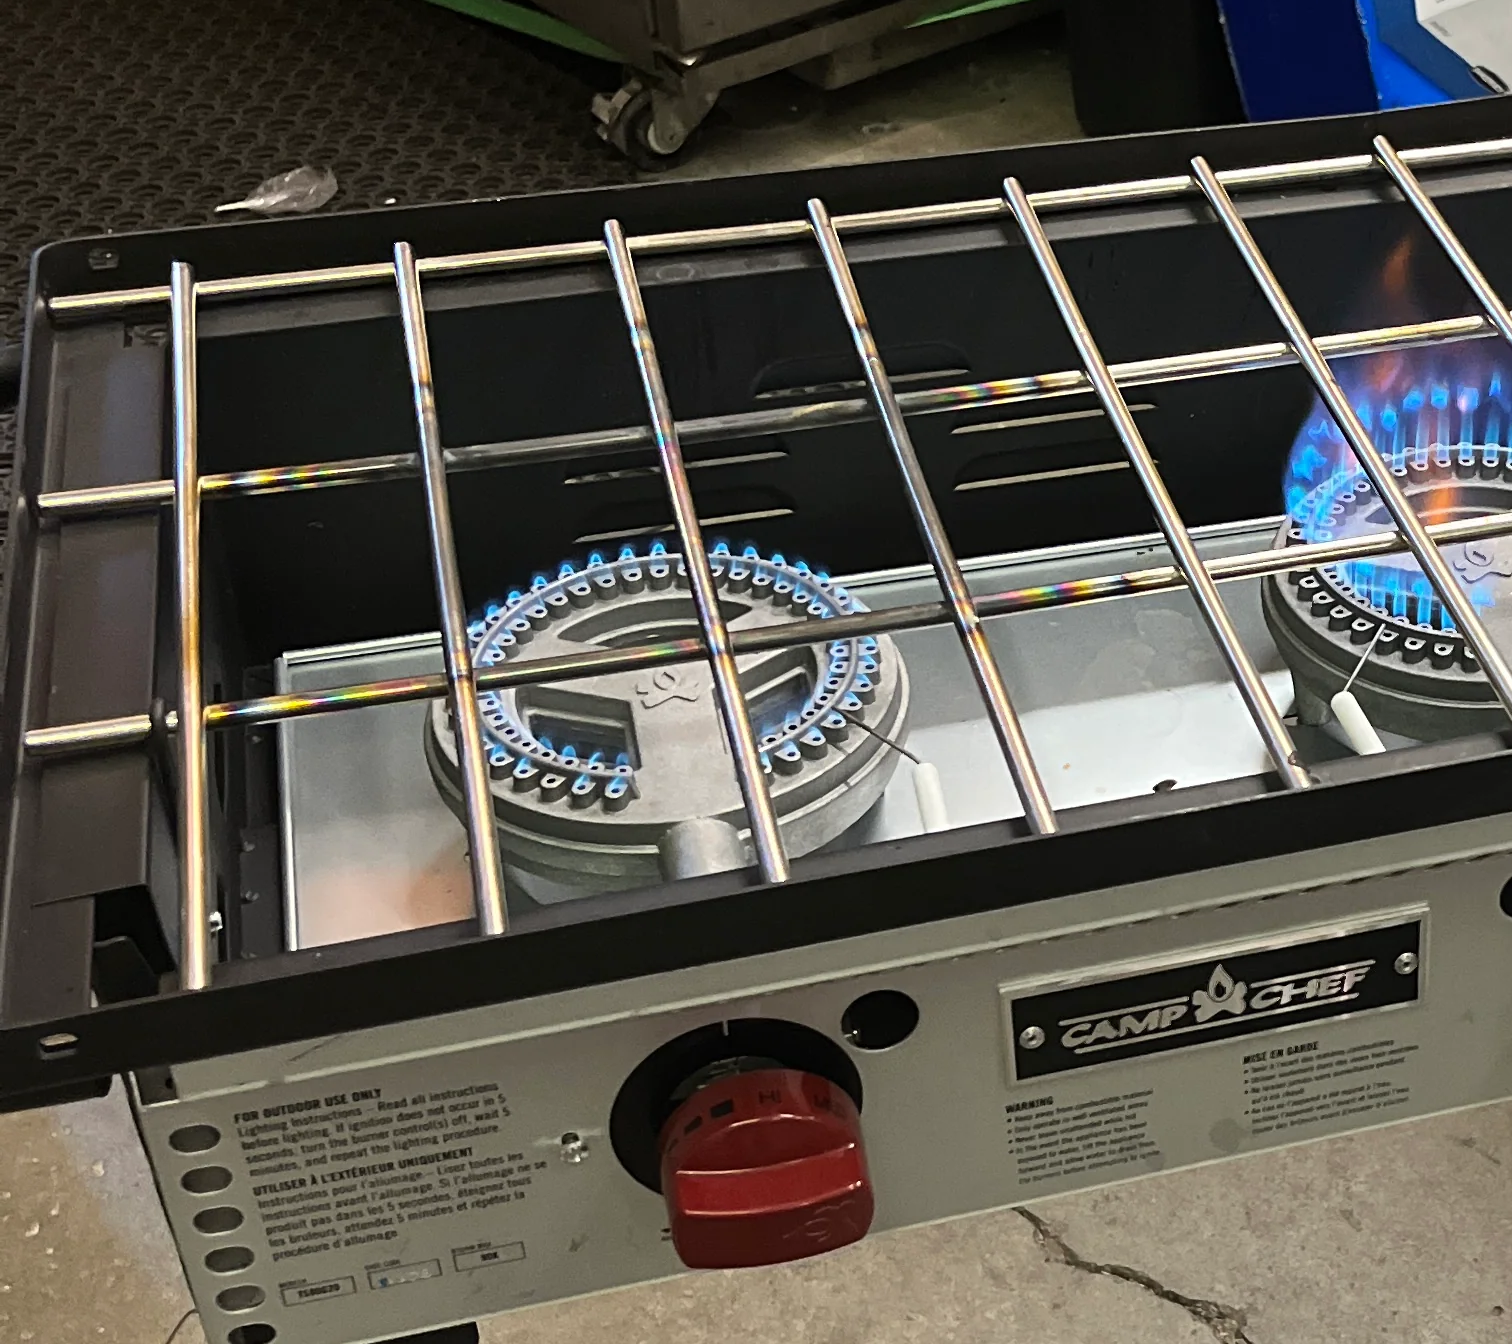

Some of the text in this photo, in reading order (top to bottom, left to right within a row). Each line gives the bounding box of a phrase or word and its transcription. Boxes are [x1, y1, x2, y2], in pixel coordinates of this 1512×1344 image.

[1060, 965, 1374, 1049] CAMP CHEF
[234, 1088, 381, 1124] FOR OUTDOOR USE ONLY
[237, 1122, 288, 1138] Lighting
[377, 1098, 408, 1111] Read
[430, 1084, 498, 1102] instructions
[242, 1137, 279, 1150] before
[396, 1111, 424, 1122] does
[427, 1104, 445, 1116] not
[448, 1100, 480, 1112] occur
[1006, 1096, 1054, 1114] WARNING
[300, 1142, 326, 1154] turn
[328, 1138, 348, 1149] the
[351, 1131, 389, 1144] burner
[393, 1118, 449, 1137] control(s)
[475, 1109, 499, 1122] wait
[305, 1154, 328, 1167] and
[331, 1148, 368, 1162] repeat
[370, 1145, 390, 1154] the
[393, 1136, 439, 1151] lighting
[253, 1178, 306, 1196] UTILISER
[321, 1162, 394, 1184] L'EXTÉRIEUR
[398, 1147, 472, 1169] UNIQUEMENT
[261, 1202, 331, 1222] instructions
[336, 1194, 368, 1208] avant
[439, 1178, 451, 1189] Si
[454, 1168, 514, 1185] l'allumage
[518, 1164, 531, 1173] ne
[534, 1161, 547, 1170] se
[332, 1184, 358, 1197] pour
[361, 1172, 423, 1189] l'allumage
[469, 1156, 504, 1170] toutes
[507, 1153, 524, 1162] les
[266, 1219, 307, 1236] produit
[311, 1216, 332, 1228] pas
[336, 1210, 364, 1222] dans
[366, 1205, 384, 1216] les
[506, 1176, 532, 1188] tous
[268, 1238, 286, 1247] les
[345, 1218, 393, 1233] attendez
[408, 1206, 453, 1221] minutes
[456, 1202, 468, 1212] et
[514, 1191, 525, 1200] la
[272, 1243, 330, 1262] procédure
